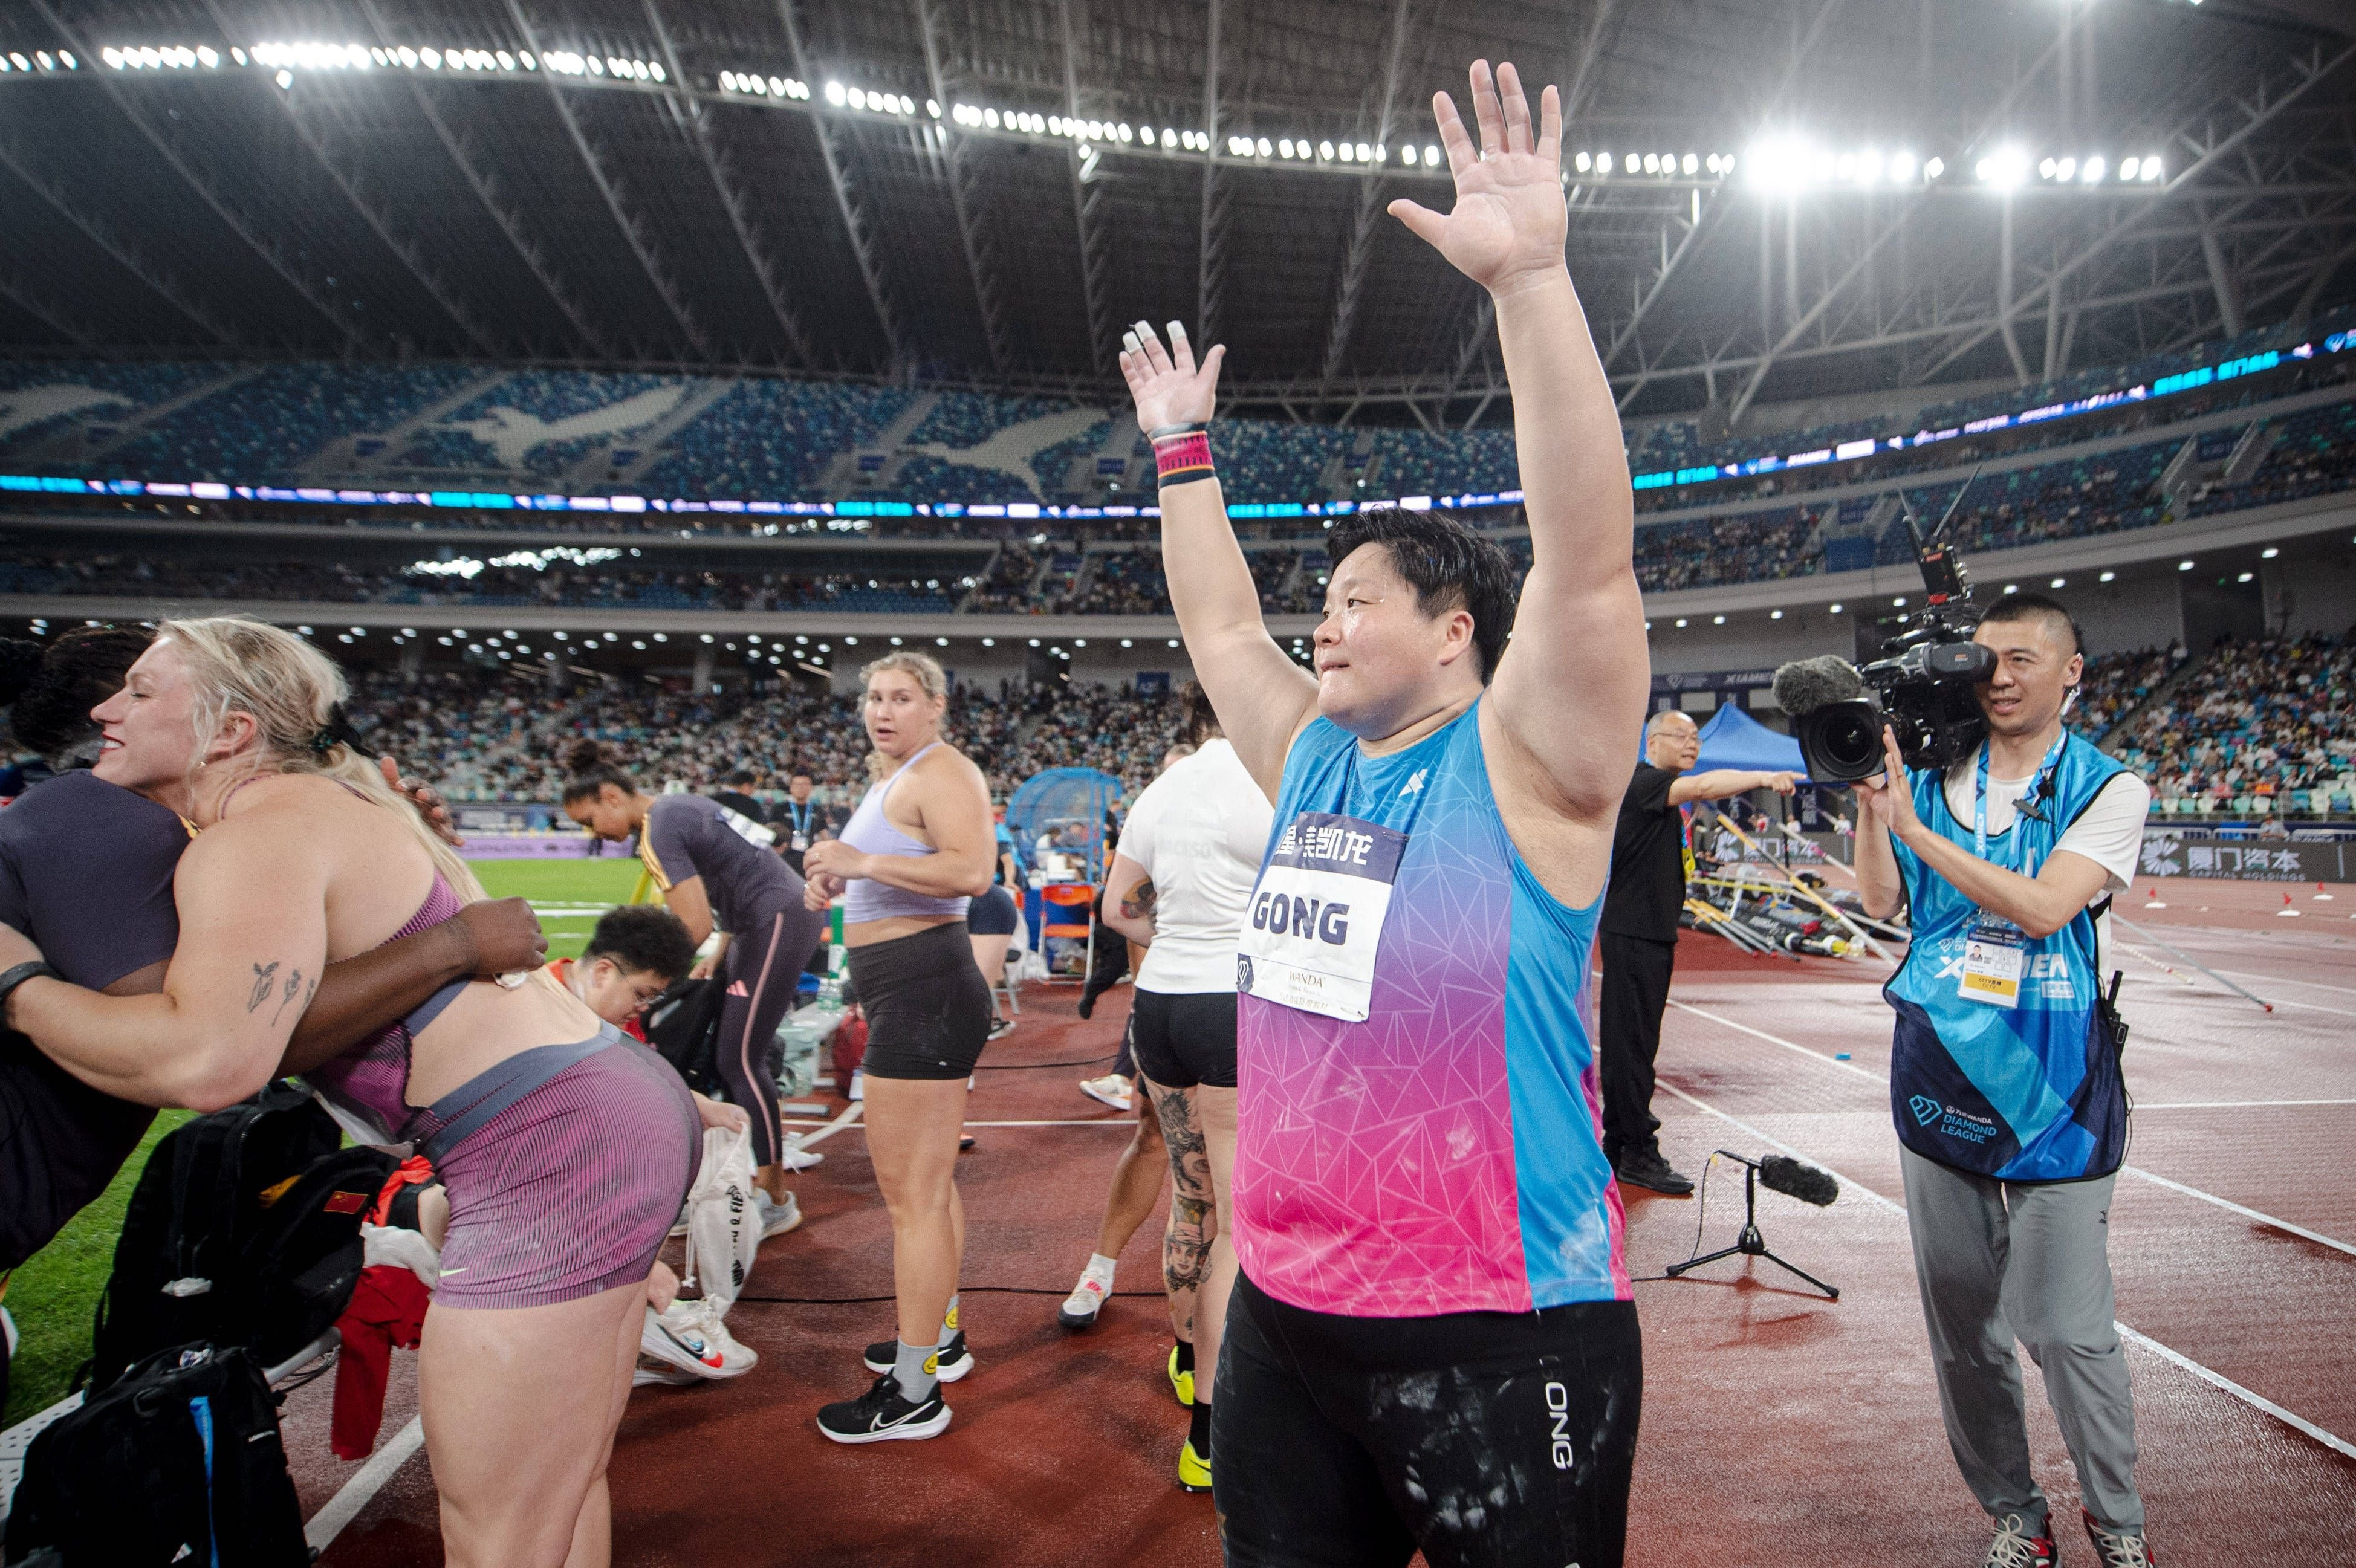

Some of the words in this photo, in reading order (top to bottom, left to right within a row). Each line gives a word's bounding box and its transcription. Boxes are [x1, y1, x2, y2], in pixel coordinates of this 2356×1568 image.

[2187, 846, 2301, 873] 厦门资本
[1253, 891, 1350, 945] GONG
[1941, 1124, 1985, 1144] LEAGUE
[1944, 1114, 1997, 1136] DIAMOND
